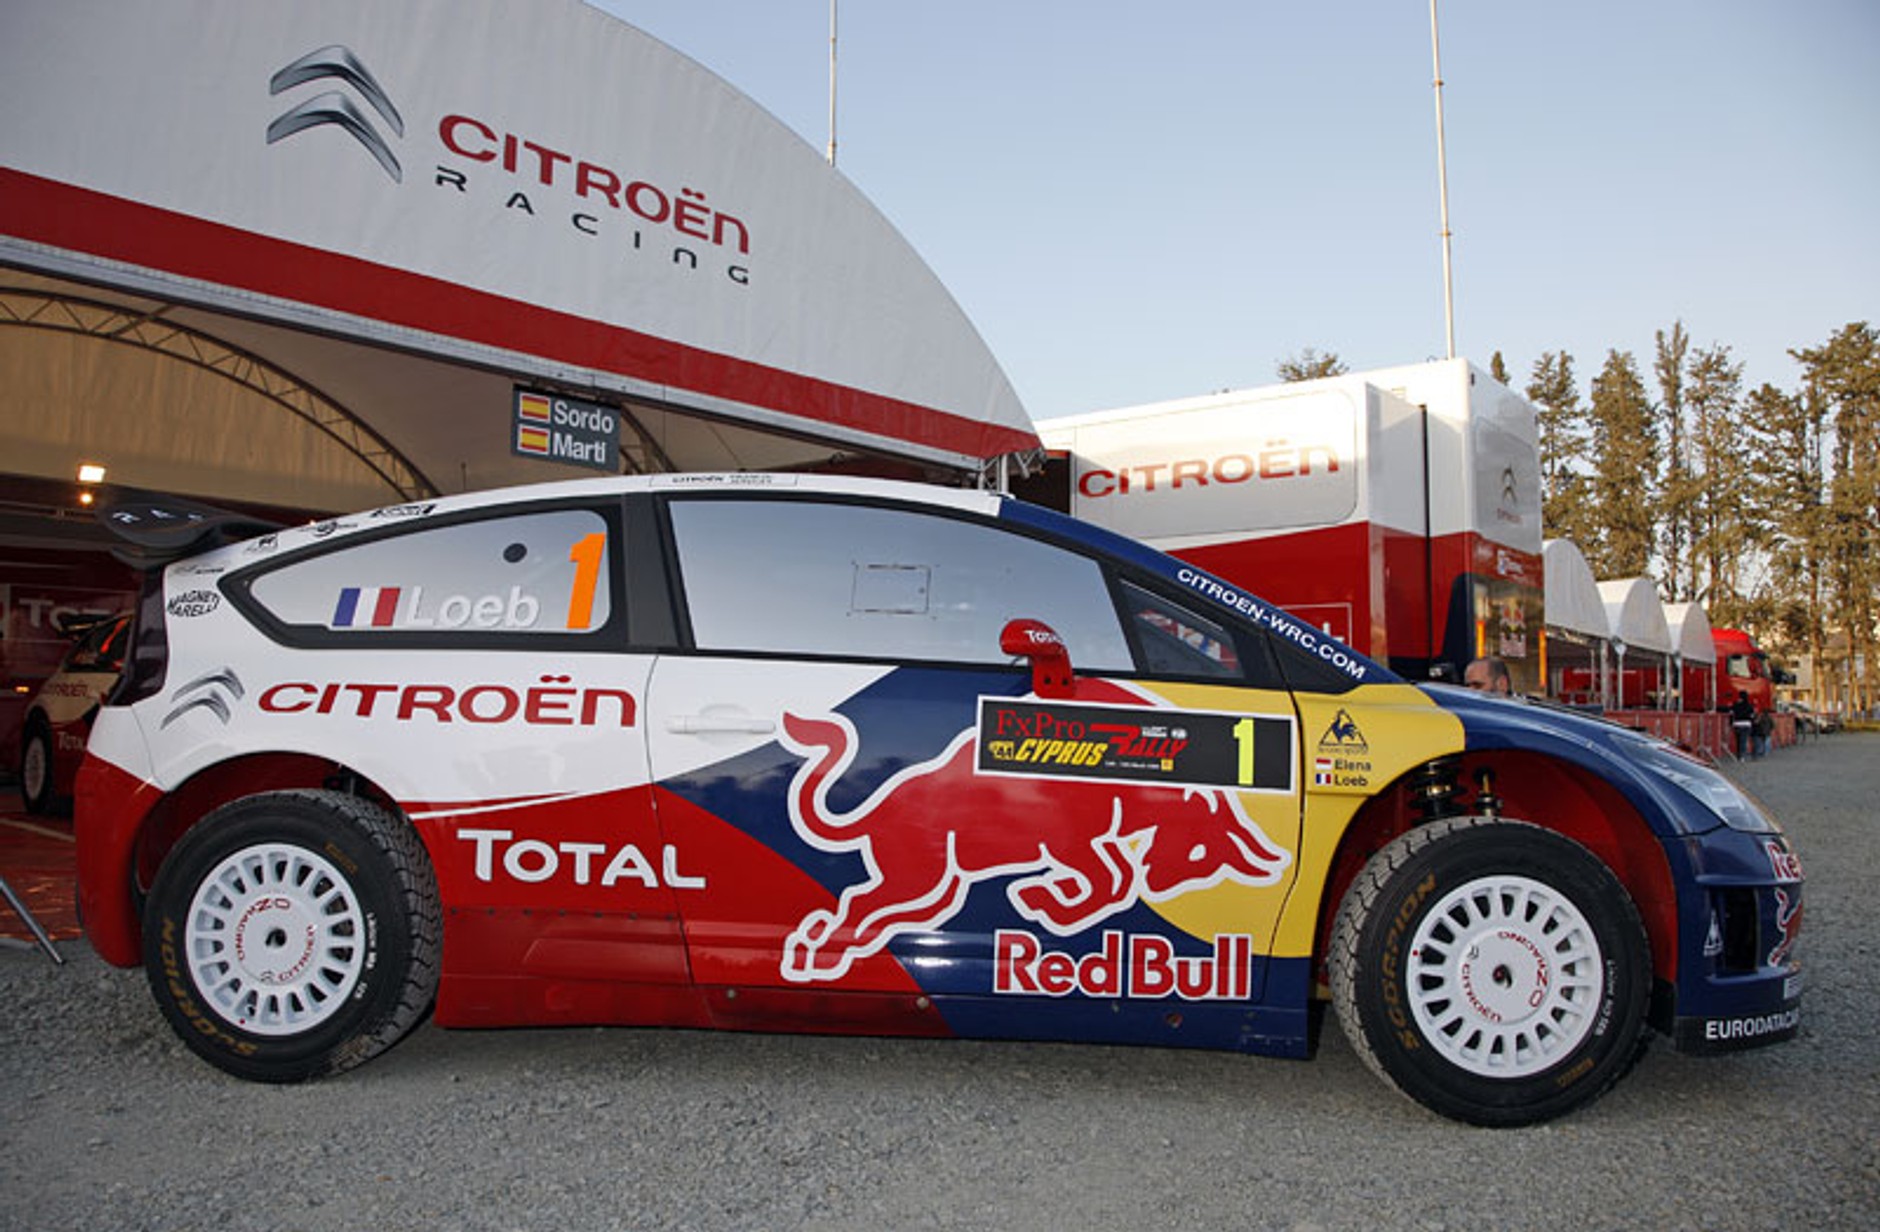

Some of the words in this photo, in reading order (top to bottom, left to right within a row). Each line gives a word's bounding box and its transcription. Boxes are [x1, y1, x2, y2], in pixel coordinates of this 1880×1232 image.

[438, 114, 750, 254] CITROËN
[435, 166, 750, 286] RACING
[554, 400, 614, 433] Sordo
[1078, 439, 1339, 499] CITROËN
[404, 585, 541, 628] Loeb
[566, 532, 606, 629] 1
[1177, 568, 1367, 680] CITROEN-WRC.COM
[258, 674, 637, 728] CITROËN
[996, 709, 1086, 741] FxPro
[1014, 738, 1109, 767] CYPRUS
[1233, 717, 1255, 787] 1
[1334, 759, 1372, 772] Elena
[1334, 774, 1369, 787] Loeb
[457, 828, 707, 890] TOTAL
[993, 928, 1124, 998] Red
[1128, 933, 1253, 1001] Bull
[1381, 872, 1438, 1051] SCORPION
